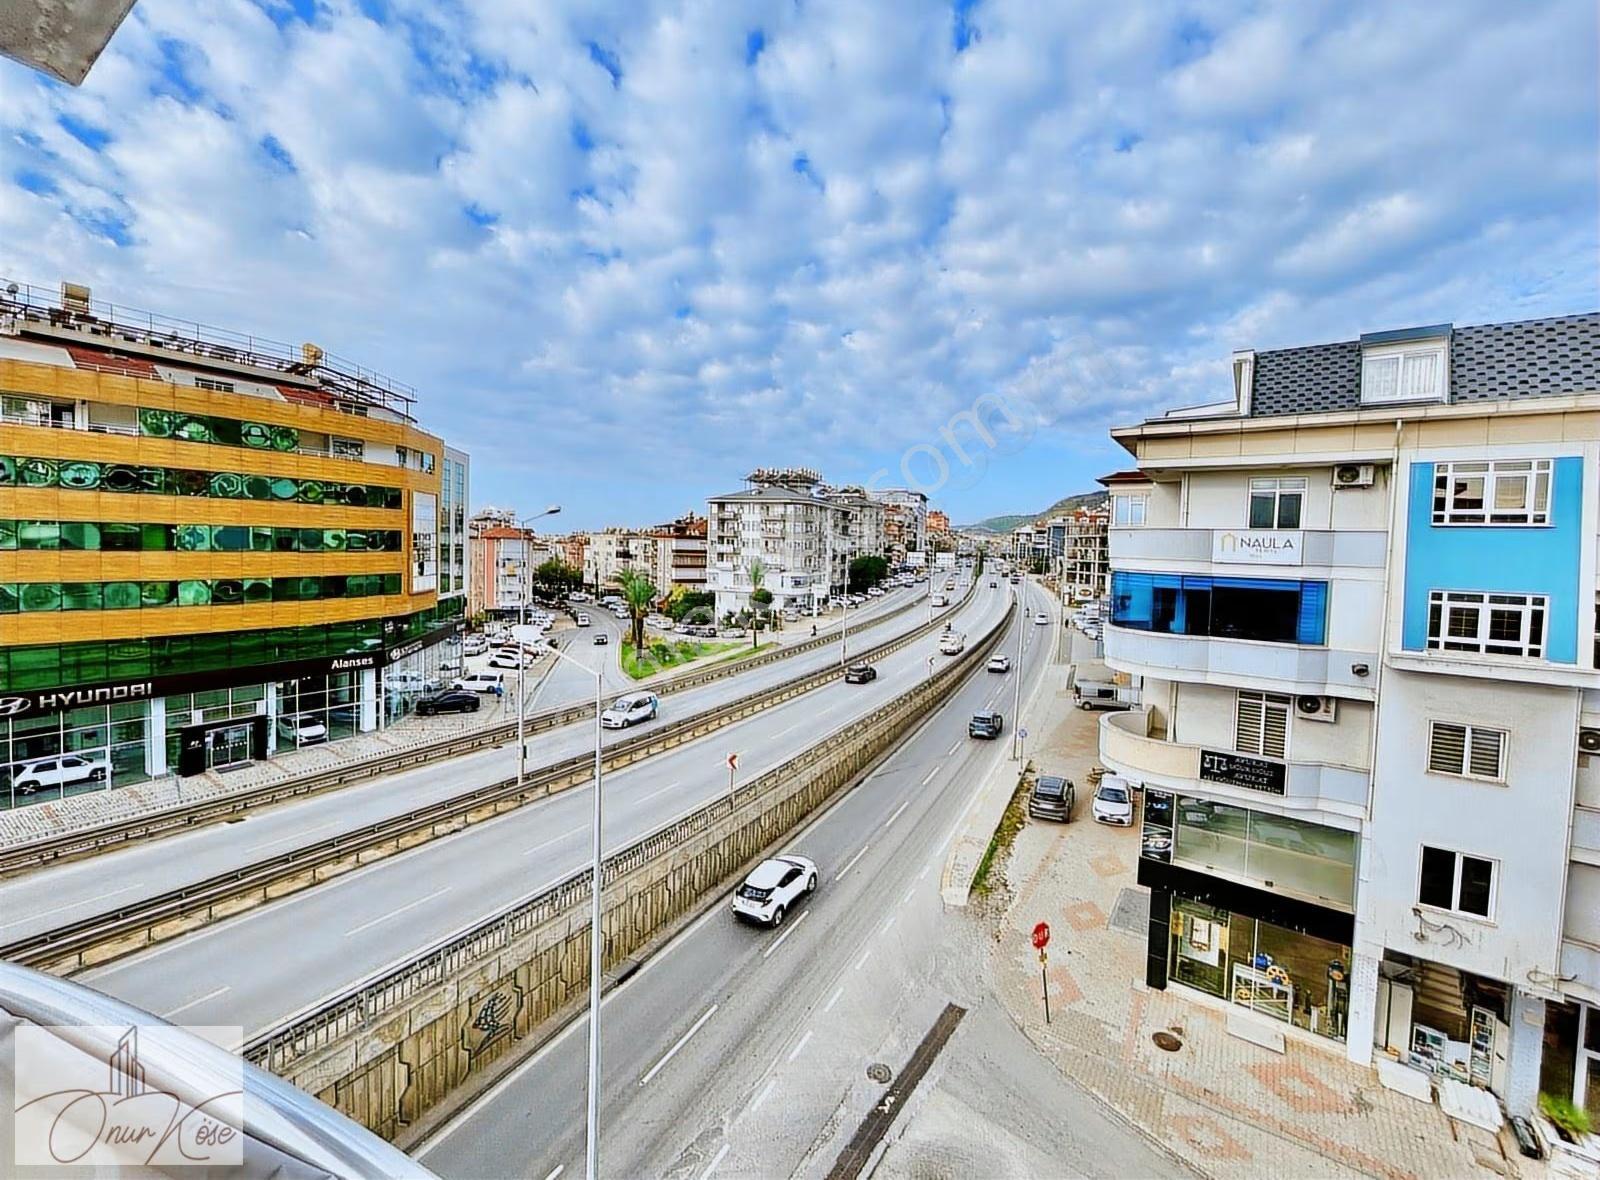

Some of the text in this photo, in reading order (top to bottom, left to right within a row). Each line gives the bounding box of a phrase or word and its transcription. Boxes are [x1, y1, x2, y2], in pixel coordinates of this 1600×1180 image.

[1240, 537, 1294, 549] NAULA
[331, 657, 374, 670] Alanses
[39, 682, 152, 708] HYUNDAI
